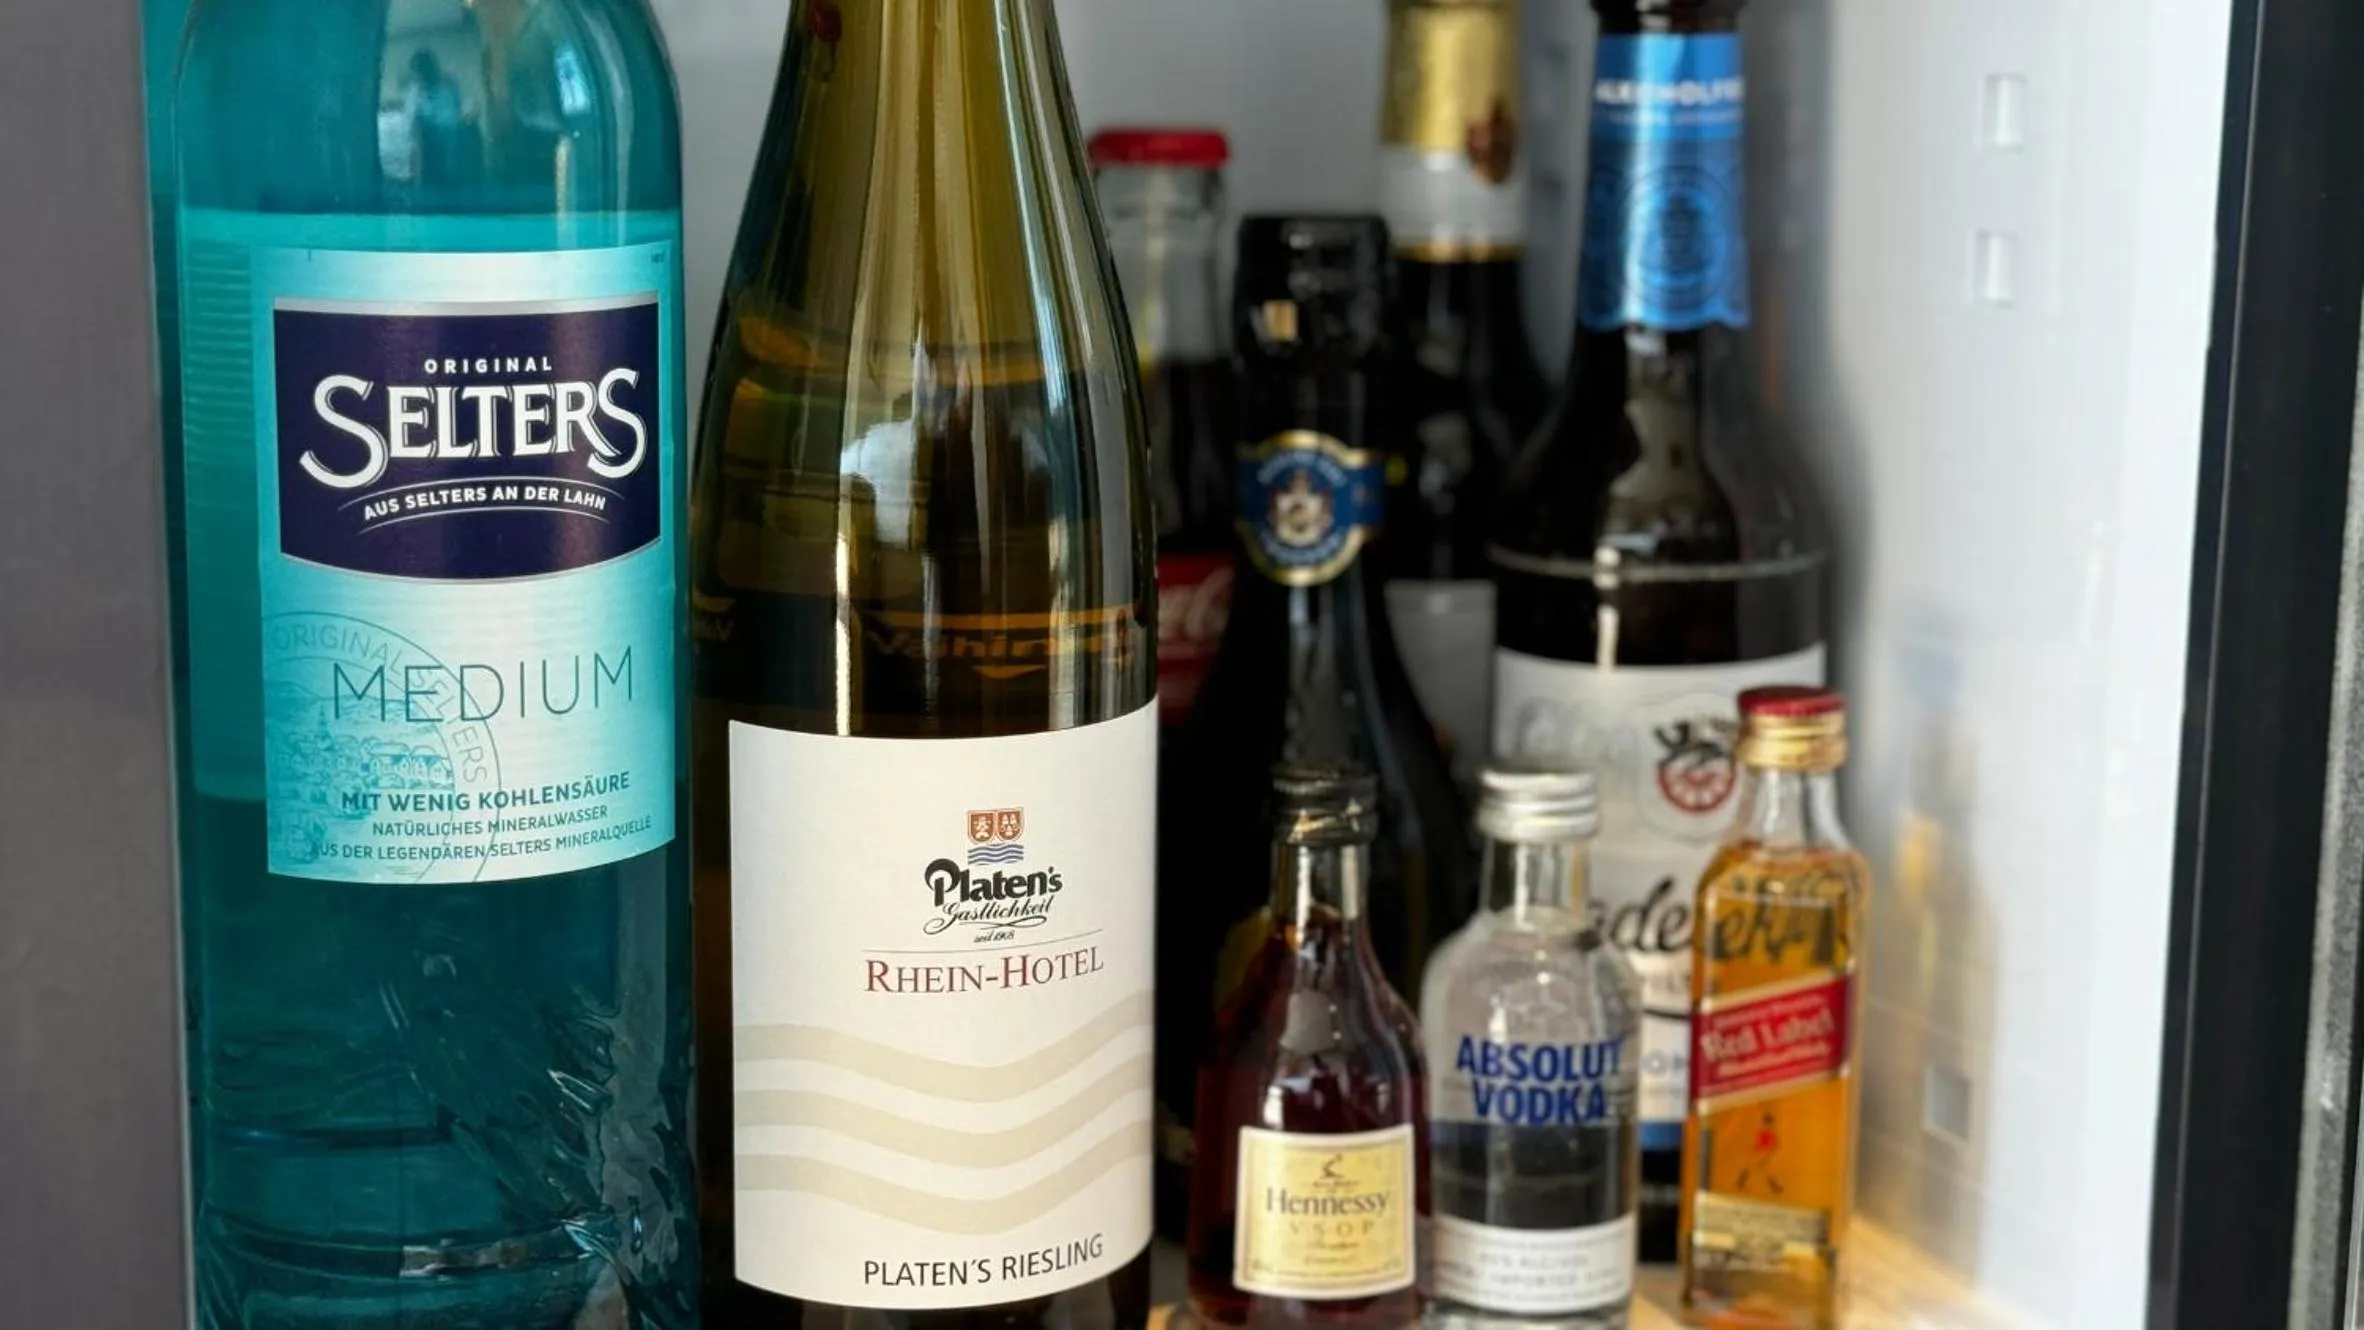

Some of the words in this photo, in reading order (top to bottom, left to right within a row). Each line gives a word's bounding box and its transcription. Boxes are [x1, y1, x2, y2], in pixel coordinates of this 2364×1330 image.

[424, 356, 552, 374] ORIGINAL
[300, 368, 647, 488] SELTERS
[365, 499, 400, 520] AUS
[406, 487, 487, 509] SELTERS
[492, 487, 518, 500] AN
[524, 487, 558, 501] DER
[564, 490, 606, 510] LAHN
[275, 624, 402, 676] ORIGINAL
[333, 645, 633, 722] MEDIUM
[341, 793, 382, 810] MIT
[389, 792, 470, 811] WENIG
[479, 771, 630, 809] KOHLENSÄURE
[343, 843, 373, 859] DER
[378, 840, 485, 861] LEGENDÄREN
[491, 838, 551, 857] SELTERS
[555, 814, 652, 850] MINERALQUELLE
[373, 819, 482, 838] NATÜRLICHES
[488, 804, 608, 833] MINERALWASSER
[924, 858, 1063, 907] Platen's
[923, 895, 1054, 934] Gastlichkeit
[1456, 1034, 1622, 1081] ABSOLUT
[1472, 1080, 1605, 1125] VODKA
[1266, 1186, 1390, 1219] Hennessy
[1002, 1232, 1103, 1281] RIESLING
